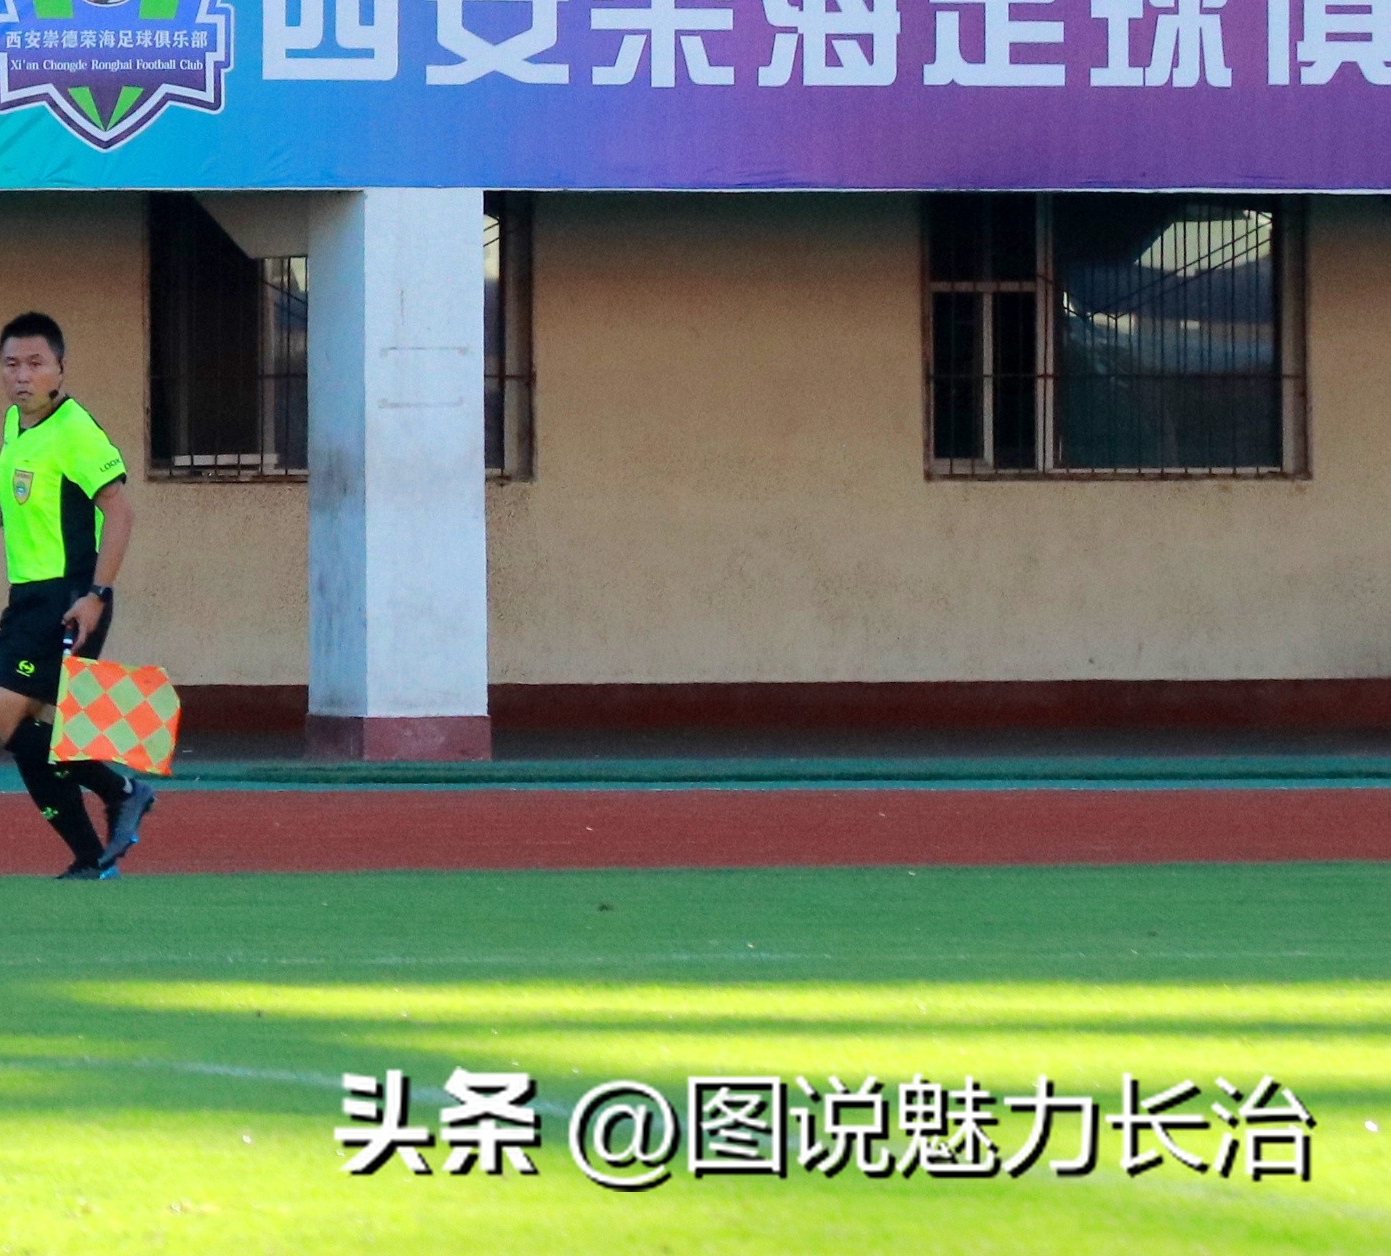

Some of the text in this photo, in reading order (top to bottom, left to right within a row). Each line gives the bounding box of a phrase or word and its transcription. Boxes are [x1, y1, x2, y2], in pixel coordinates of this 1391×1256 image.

[5, 30, 208, 49] 西安崇德荣海足球俱乐部
[10, 59, 203, 73] Xi'an Chongde Ronghai Football Club
